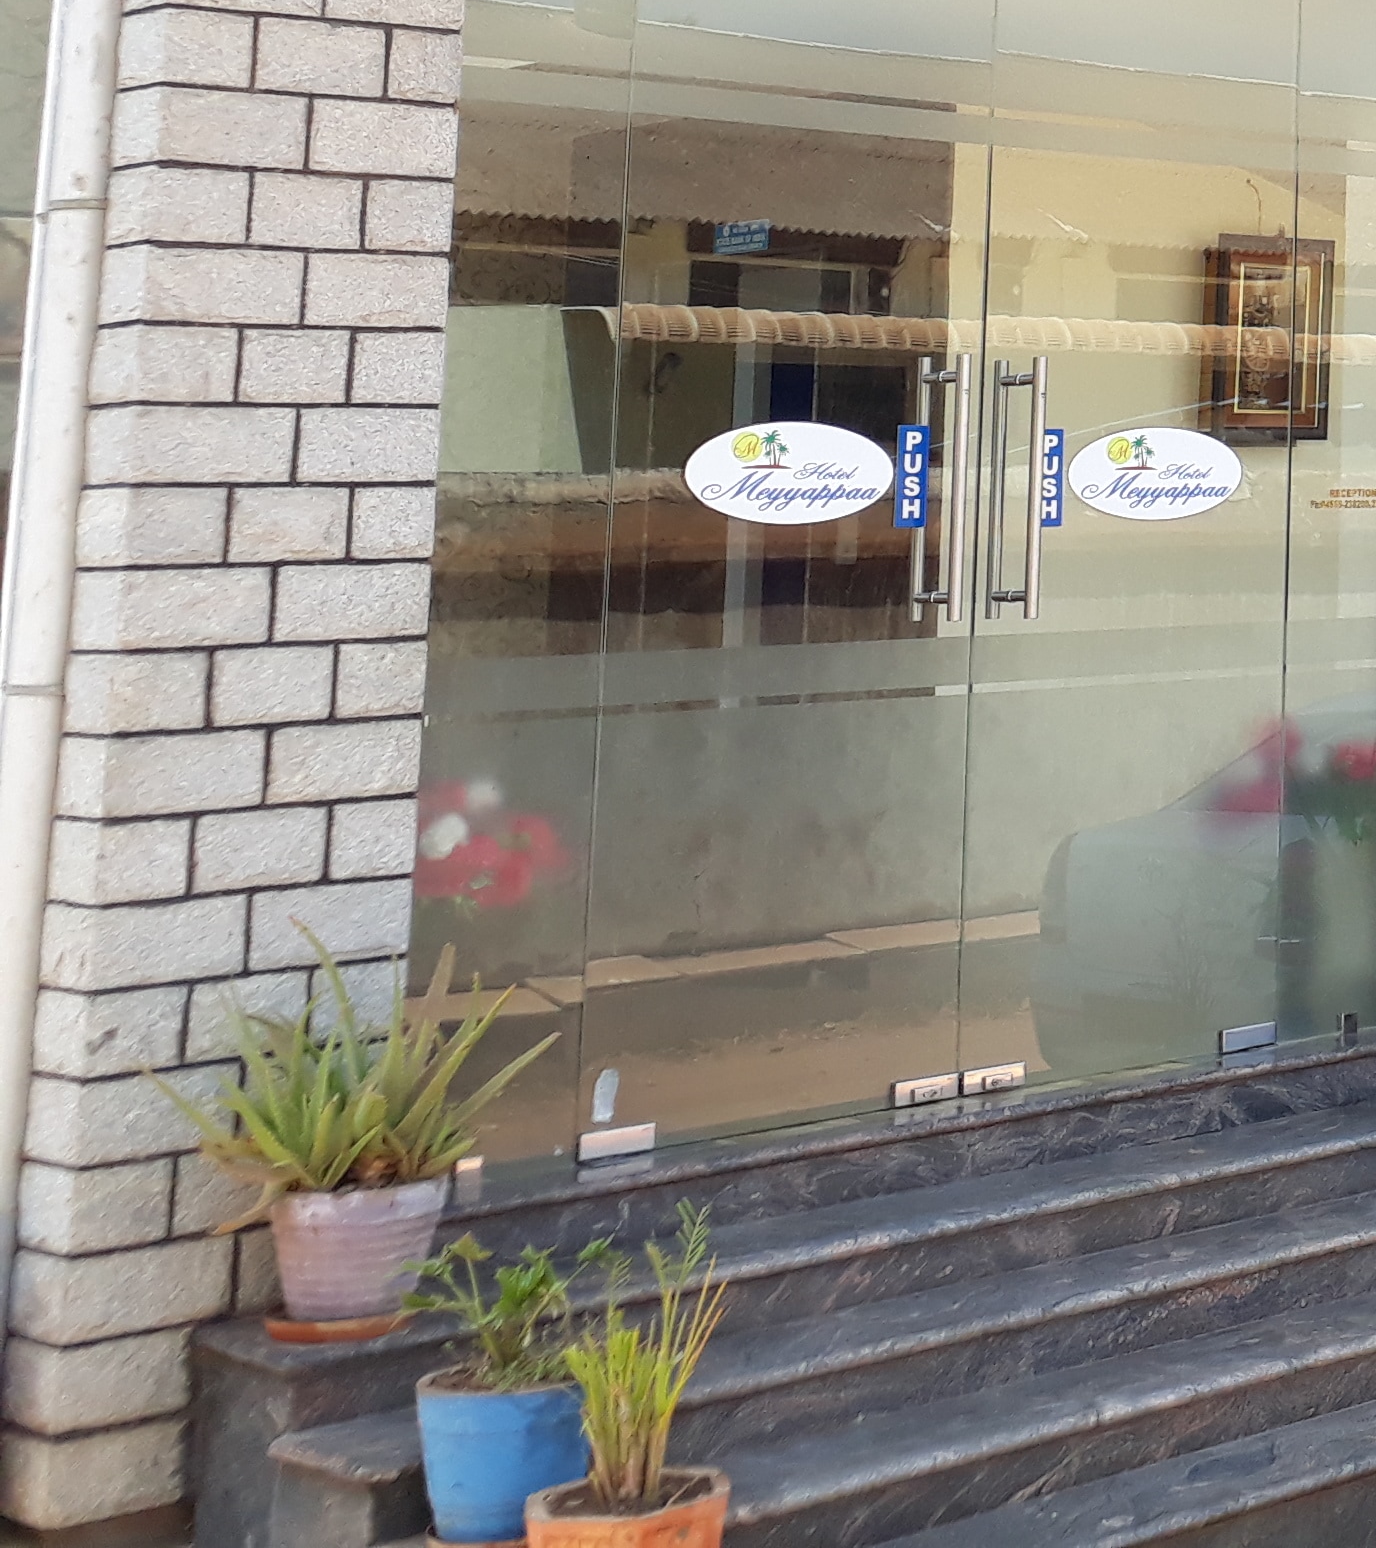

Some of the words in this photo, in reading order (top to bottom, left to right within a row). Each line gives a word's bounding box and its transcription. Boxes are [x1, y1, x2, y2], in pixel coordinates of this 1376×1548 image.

[793, 462, 859, 481] Hotel
[902, 431, 923, 520] PUSH
[1041, 434, 1059, 520] PUSH
[1081, 472, 1231, 509] Meyyappaa
[1158, 463, 1214, 480] Hotel
[700, 471, 881, 511] Meyyappaa
